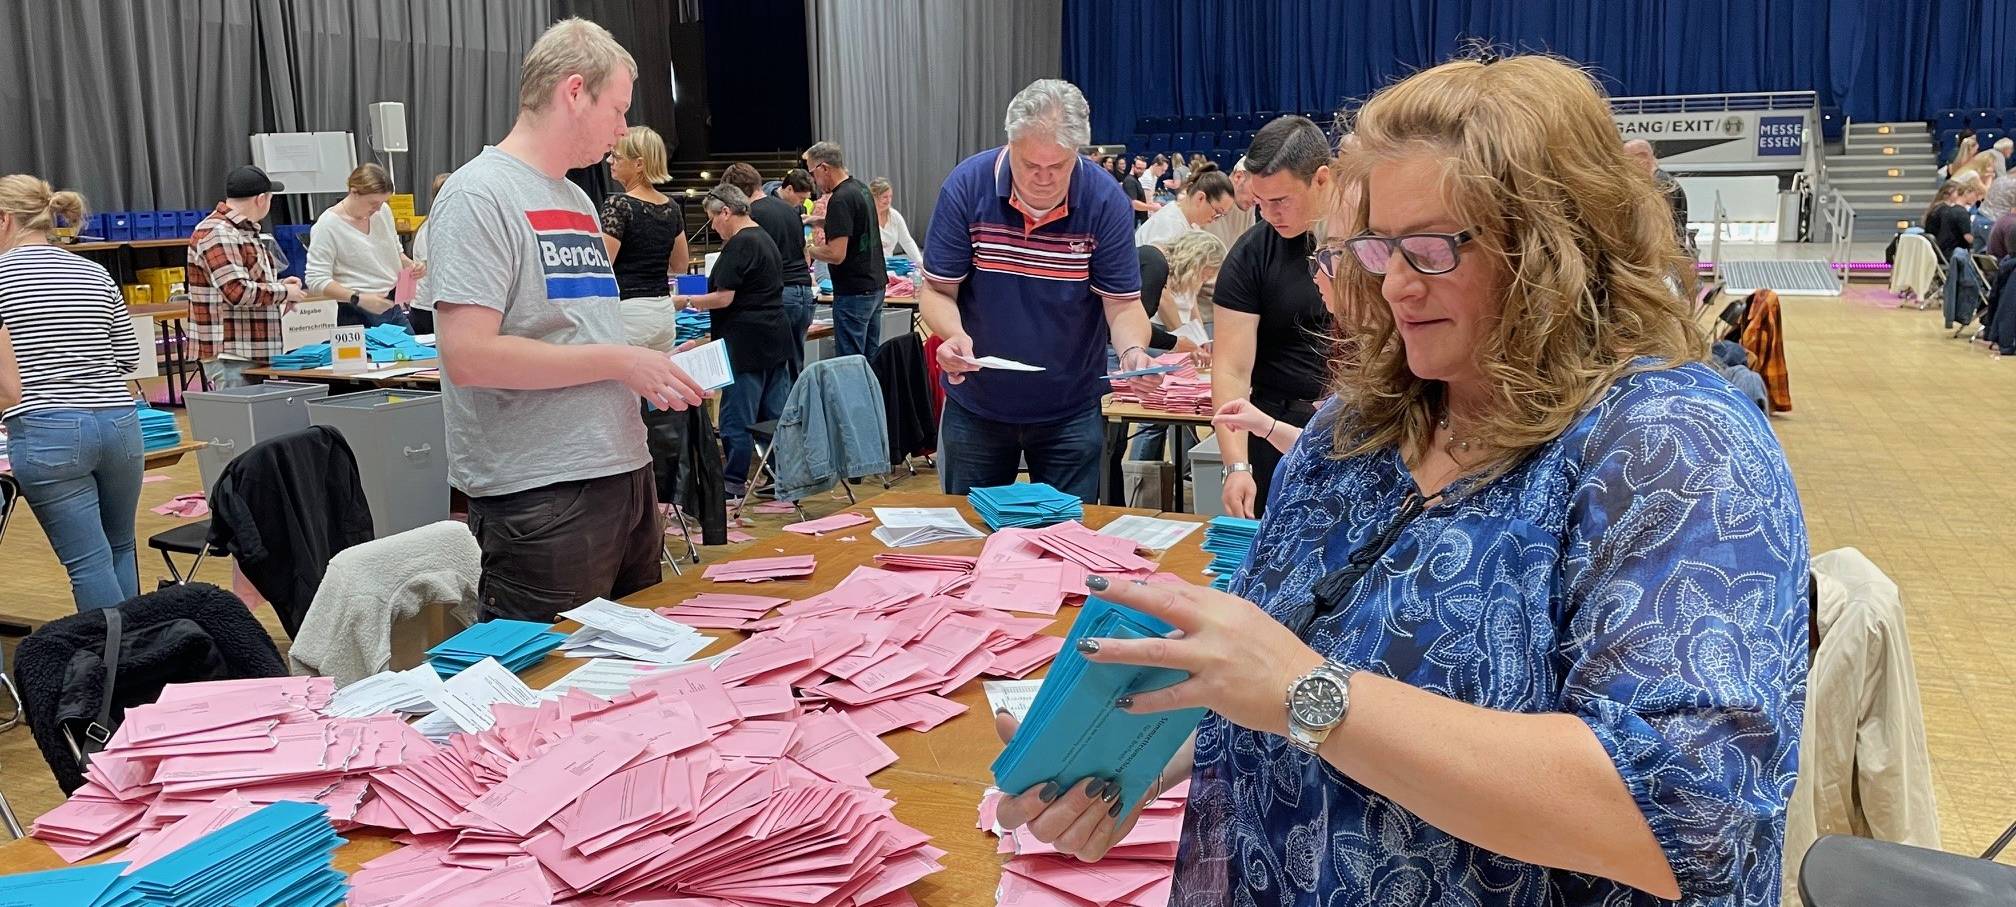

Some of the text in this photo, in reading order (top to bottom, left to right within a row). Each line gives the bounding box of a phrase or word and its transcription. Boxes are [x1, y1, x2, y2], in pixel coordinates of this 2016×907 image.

[1760, 123, 1801, 135] MESSE
[1759, 136, 1800, 148] ESSEN
[540, 240, 610, 268] Bench.
[289, 323, 336, 331] Niederschriften
[335, 332, 360, 343] 9030
